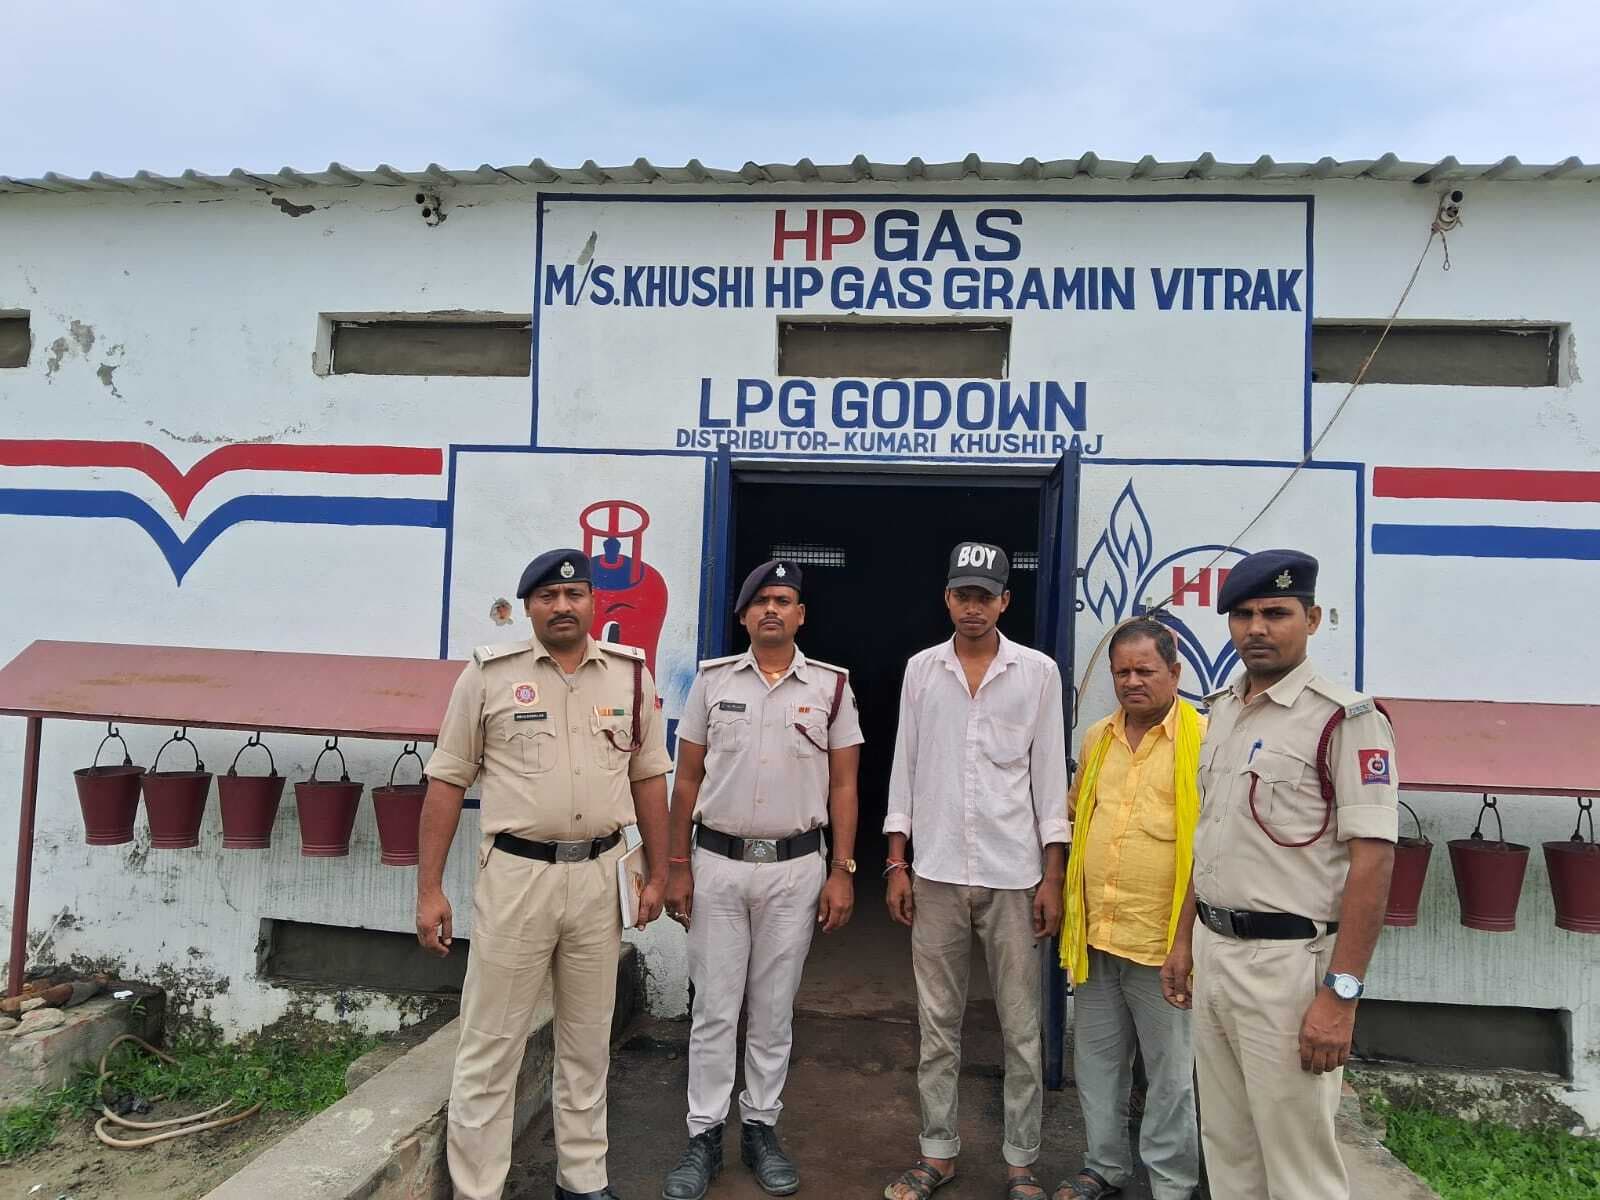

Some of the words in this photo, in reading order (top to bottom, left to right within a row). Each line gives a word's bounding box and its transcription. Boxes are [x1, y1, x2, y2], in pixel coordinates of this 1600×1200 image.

[766, 267, 824, 308] HP
[831, 266, 933, 310] GAS
[943, 267, 1136, 311] GRAMIN
[1150, 268, 1304, 312] VITRAK
[699, 377, 816, 429] LPG
[831, 380, 1087, 432] GODOWN
[950, 433, 1046, 454] KHUSHI
[1052, 434, 1104, 455] RAJ
[957, 545, 997, 570] BOY
